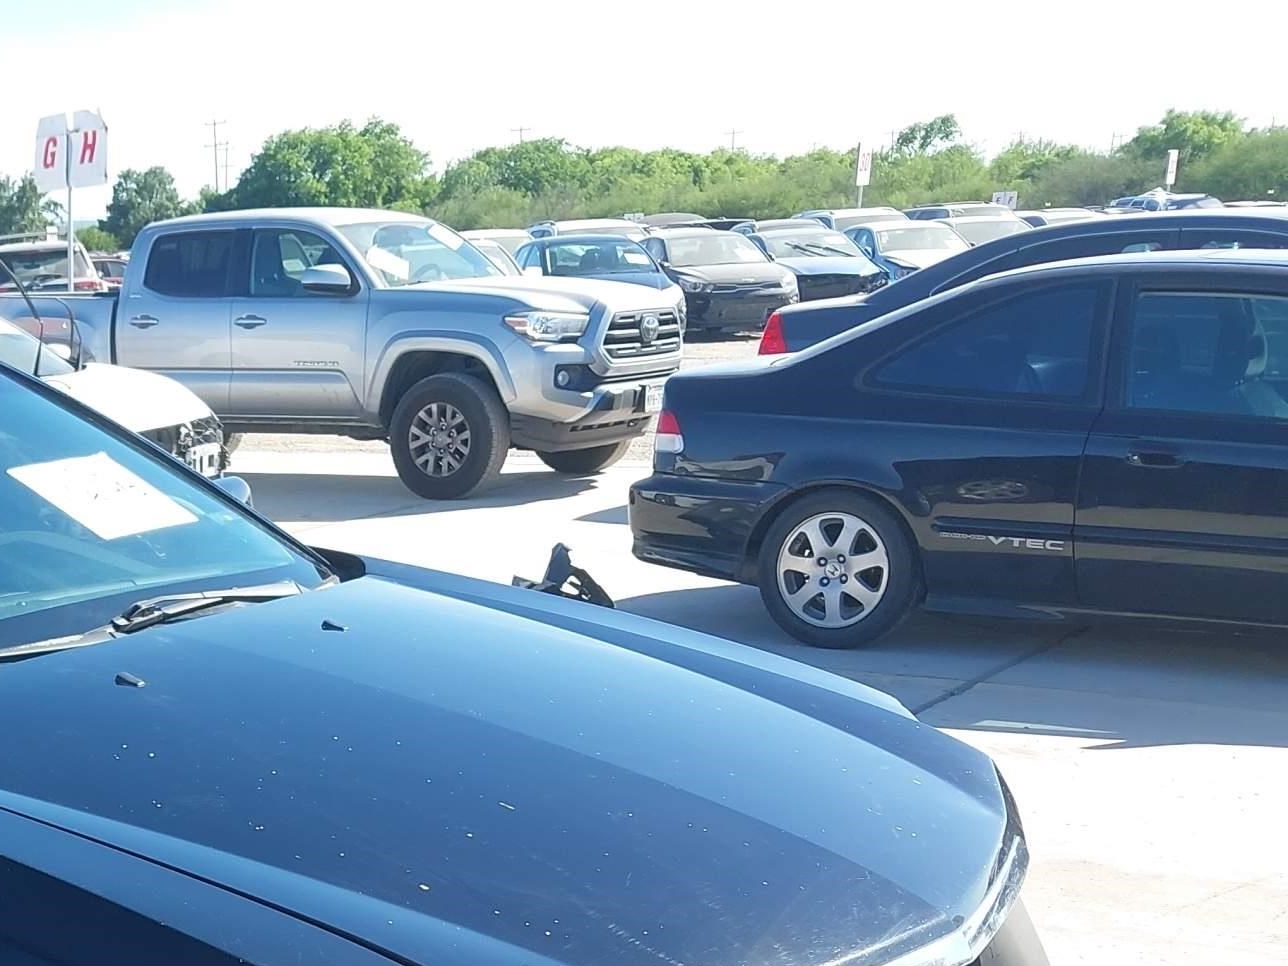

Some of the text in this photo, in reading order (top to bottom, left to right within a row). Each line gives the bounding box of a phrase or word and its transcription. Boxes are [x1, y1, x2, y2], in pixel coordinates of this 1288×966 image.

[43, 130, 97, 169] G H
[987, 535, 1065, 551] VTEC
